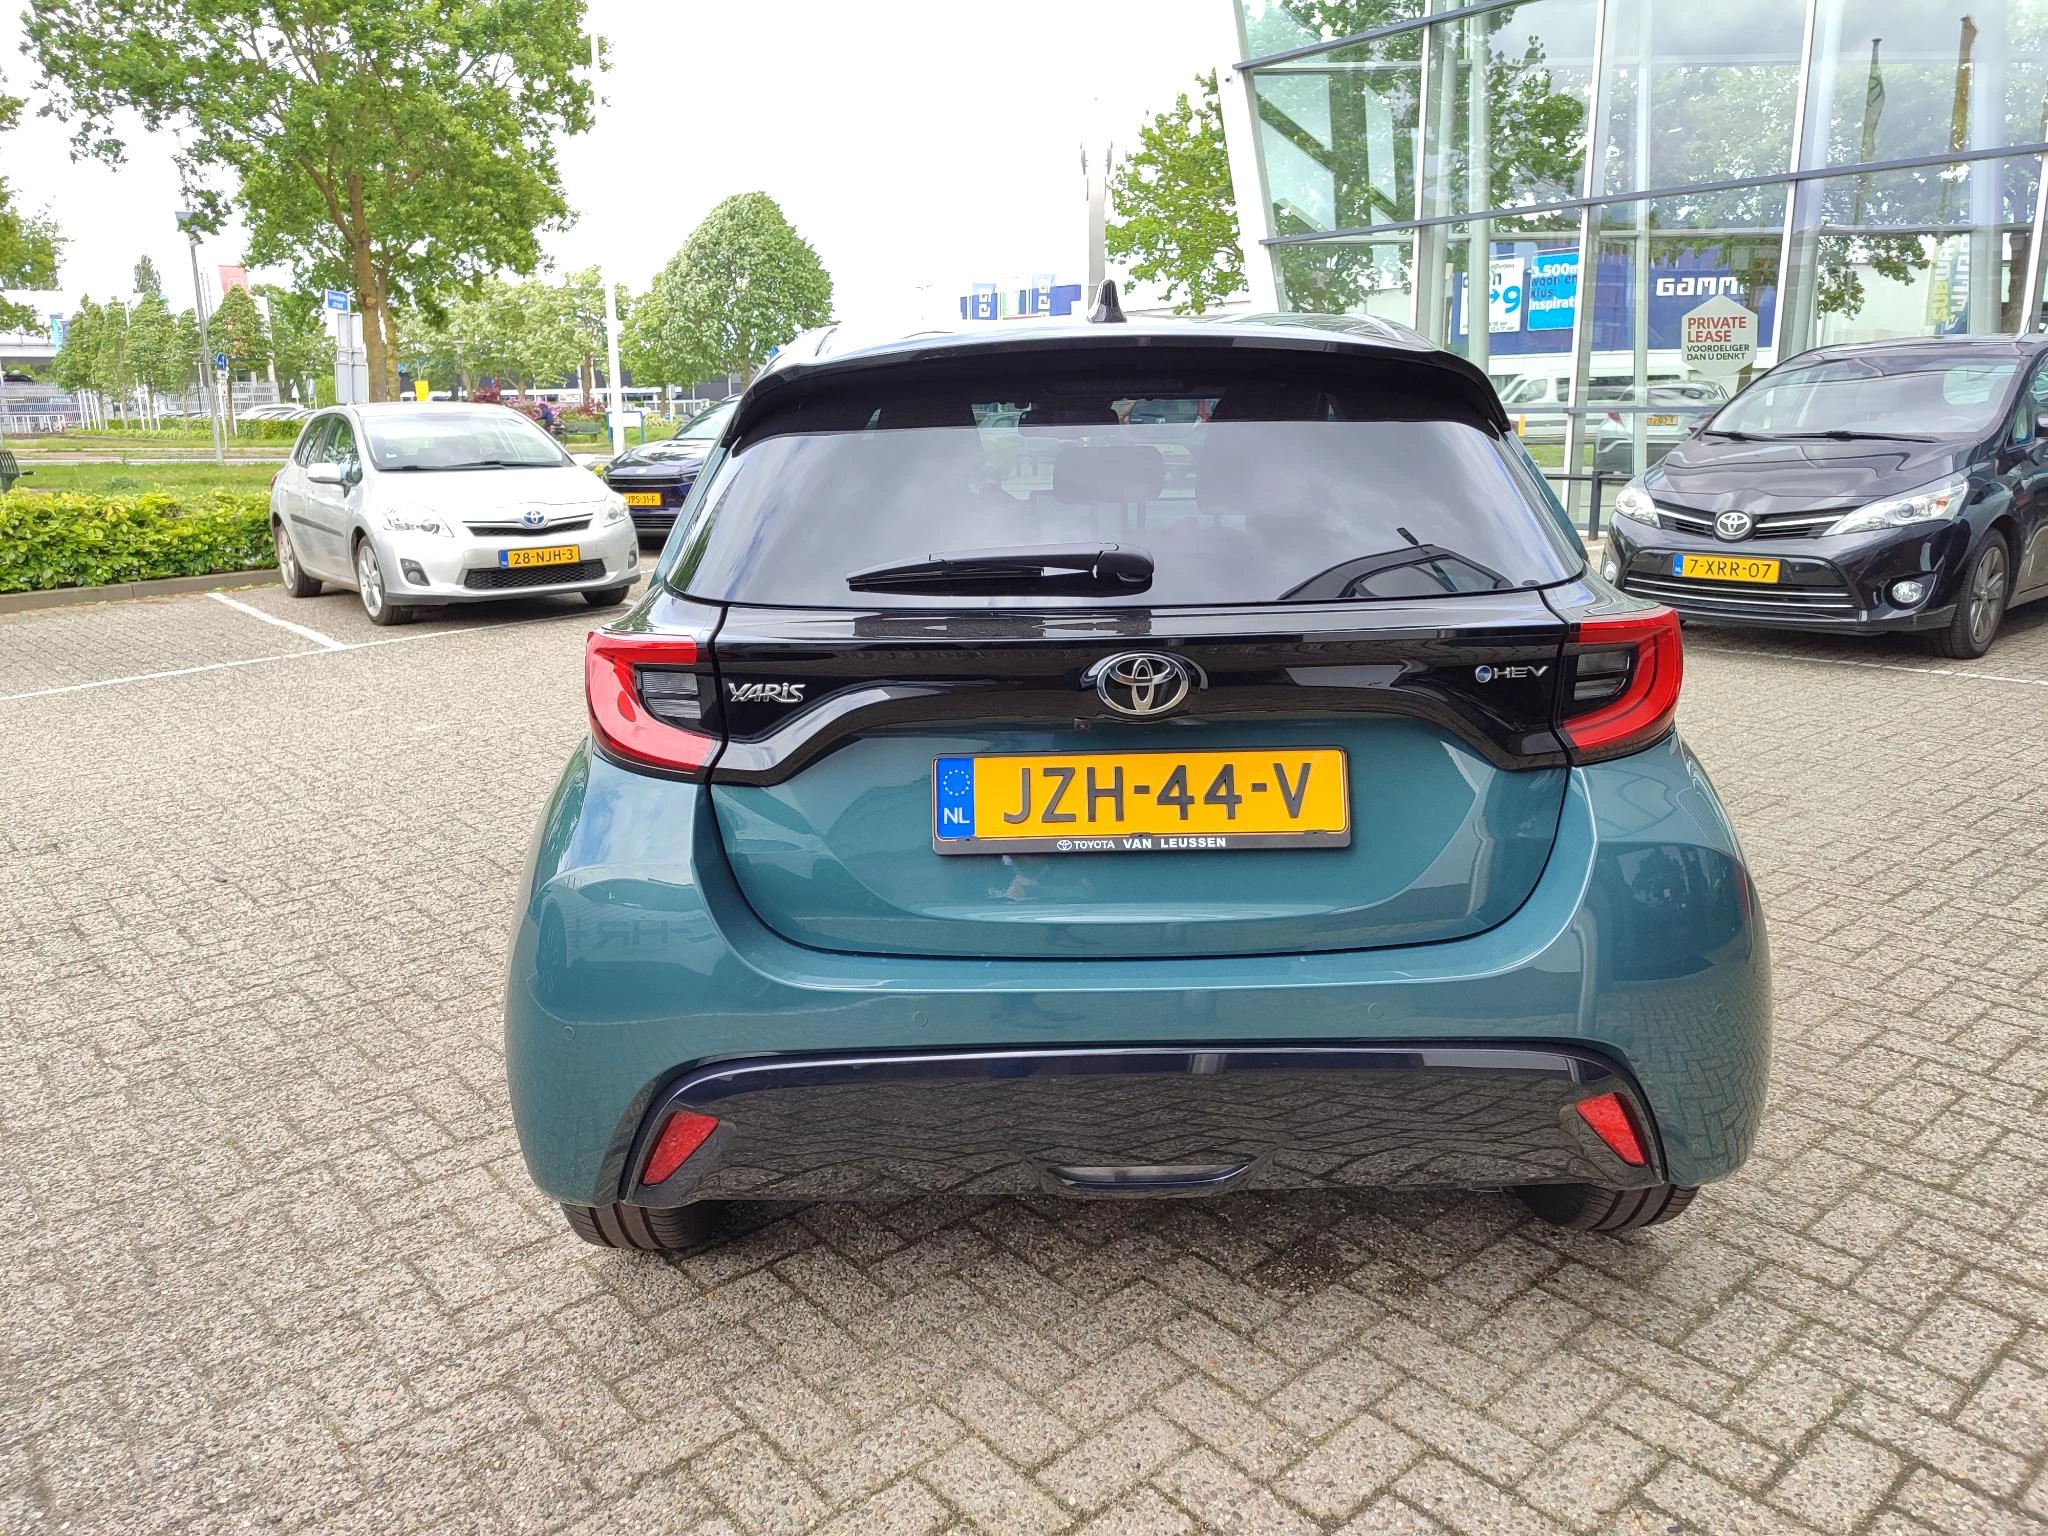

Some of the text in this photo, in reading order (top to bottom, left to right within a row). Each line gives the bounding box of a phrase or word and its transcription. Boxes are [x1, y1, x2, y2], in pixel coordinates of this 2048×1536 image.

[1687, 316, 1747, 330] PRIVATE
[1687, 330, 1732, 343] LEASE
[1686, 344, 1750, 353] VOORDELIGER
[1707, 353, 1715, 361] U
[1716, 352, 1746, 361] DENKT
[513, 548, 574, 565] 28-NJH-3
[1689, 559, 1772, 578] 7-XRR-07
[1493, 665, 1549, 680] HEV
[1003, 762, 1312, 824] JZH-44-V
[943, 806, 970, 825] NL
[1073, 837, 1227, 850] TOYOTA VAN LEUSSEN
